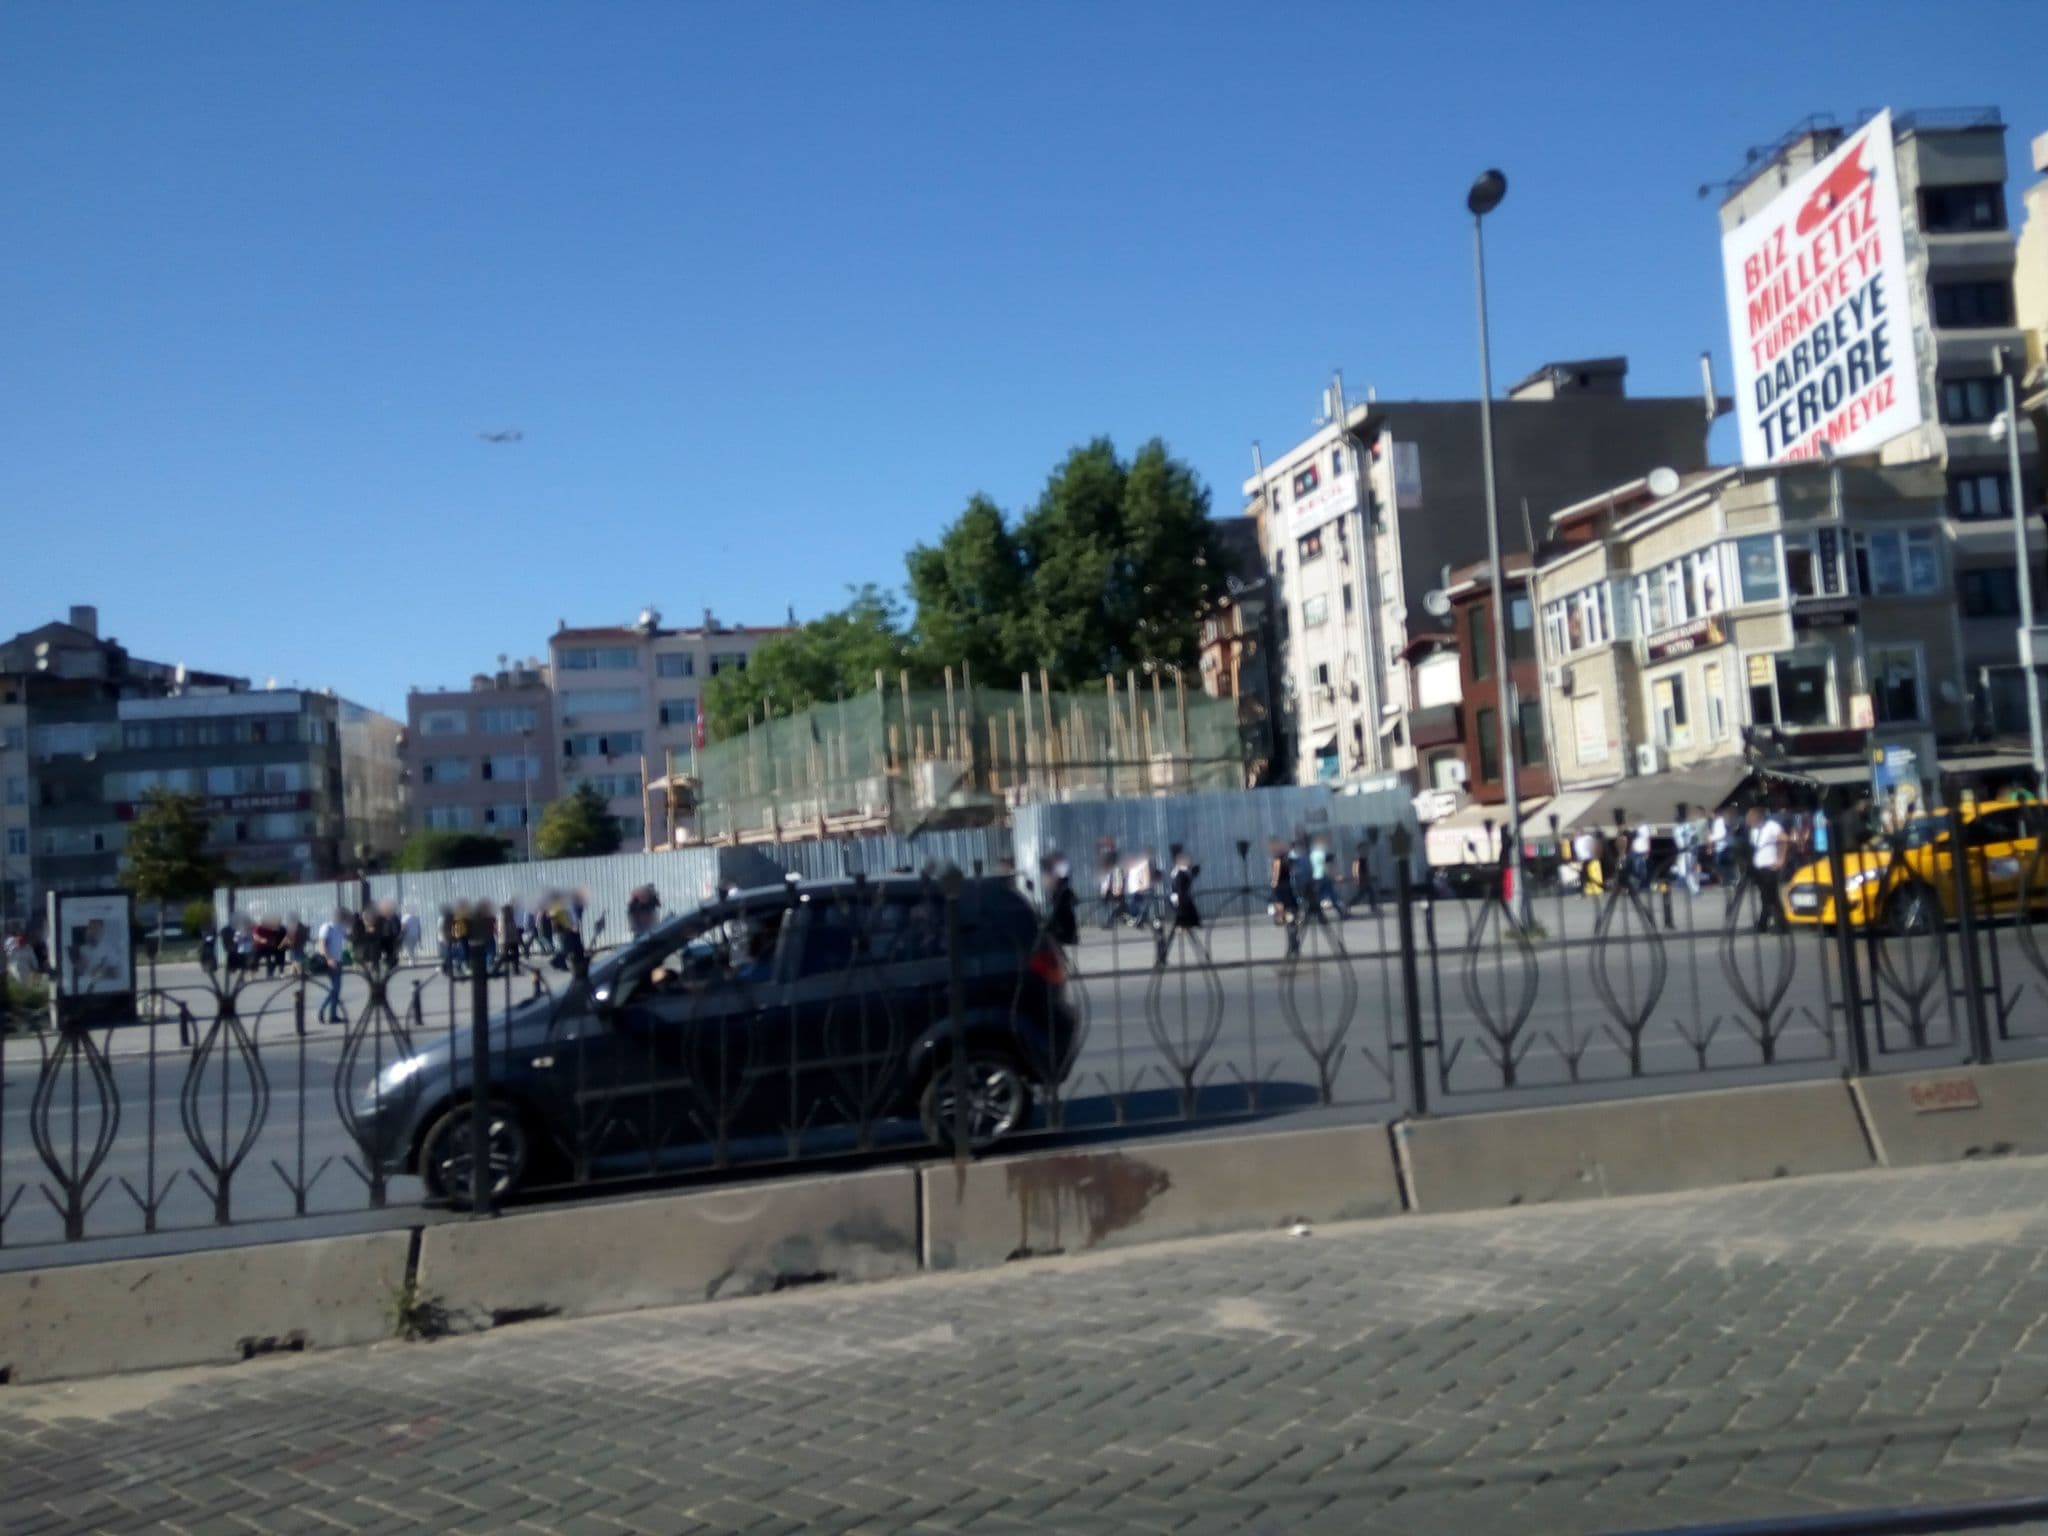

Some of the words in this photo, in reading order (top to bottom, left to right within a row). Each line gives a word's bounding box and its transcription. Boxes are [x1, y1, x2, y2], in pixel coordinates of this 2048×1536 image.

[1744, 222, 1787, 295] BİZ
[1748, 182, 1879, 338] MİLLETİZ
[1755, 271, 1887, 415] DARBEYE
[1759, 320, 1893, 459] TERÖRE
